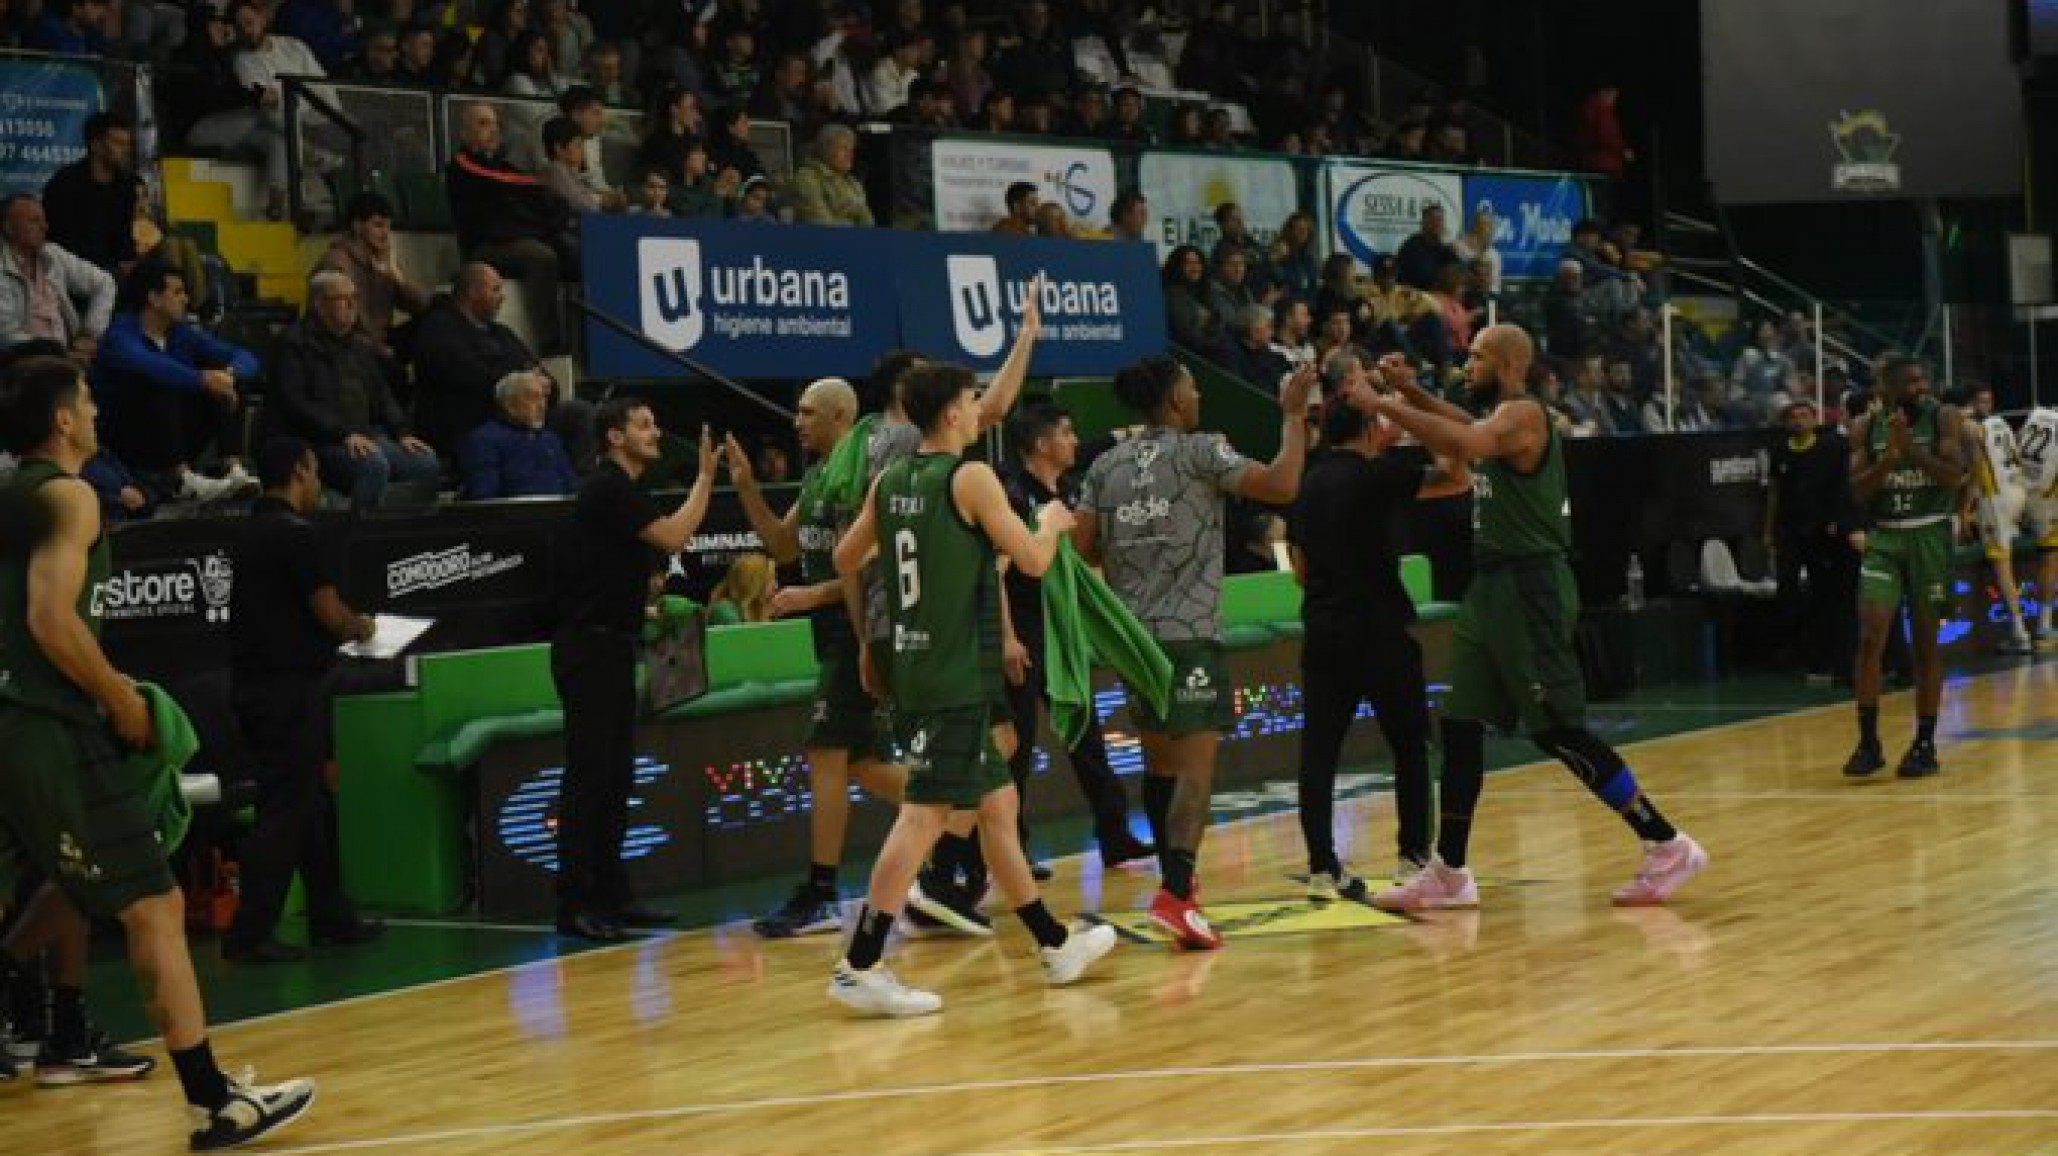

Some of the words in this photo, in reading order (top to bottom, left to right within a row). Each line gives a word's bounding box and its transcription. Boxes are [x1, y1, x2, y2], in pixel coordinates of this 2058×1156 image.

[711, 254, 848, 309] urbana
[1006, 267, 1120, 316] ubana
[713, 311, 773, 340] higiene
[777, 313, 851, 338] ambiental
[895, 527, 921, 611] 6
